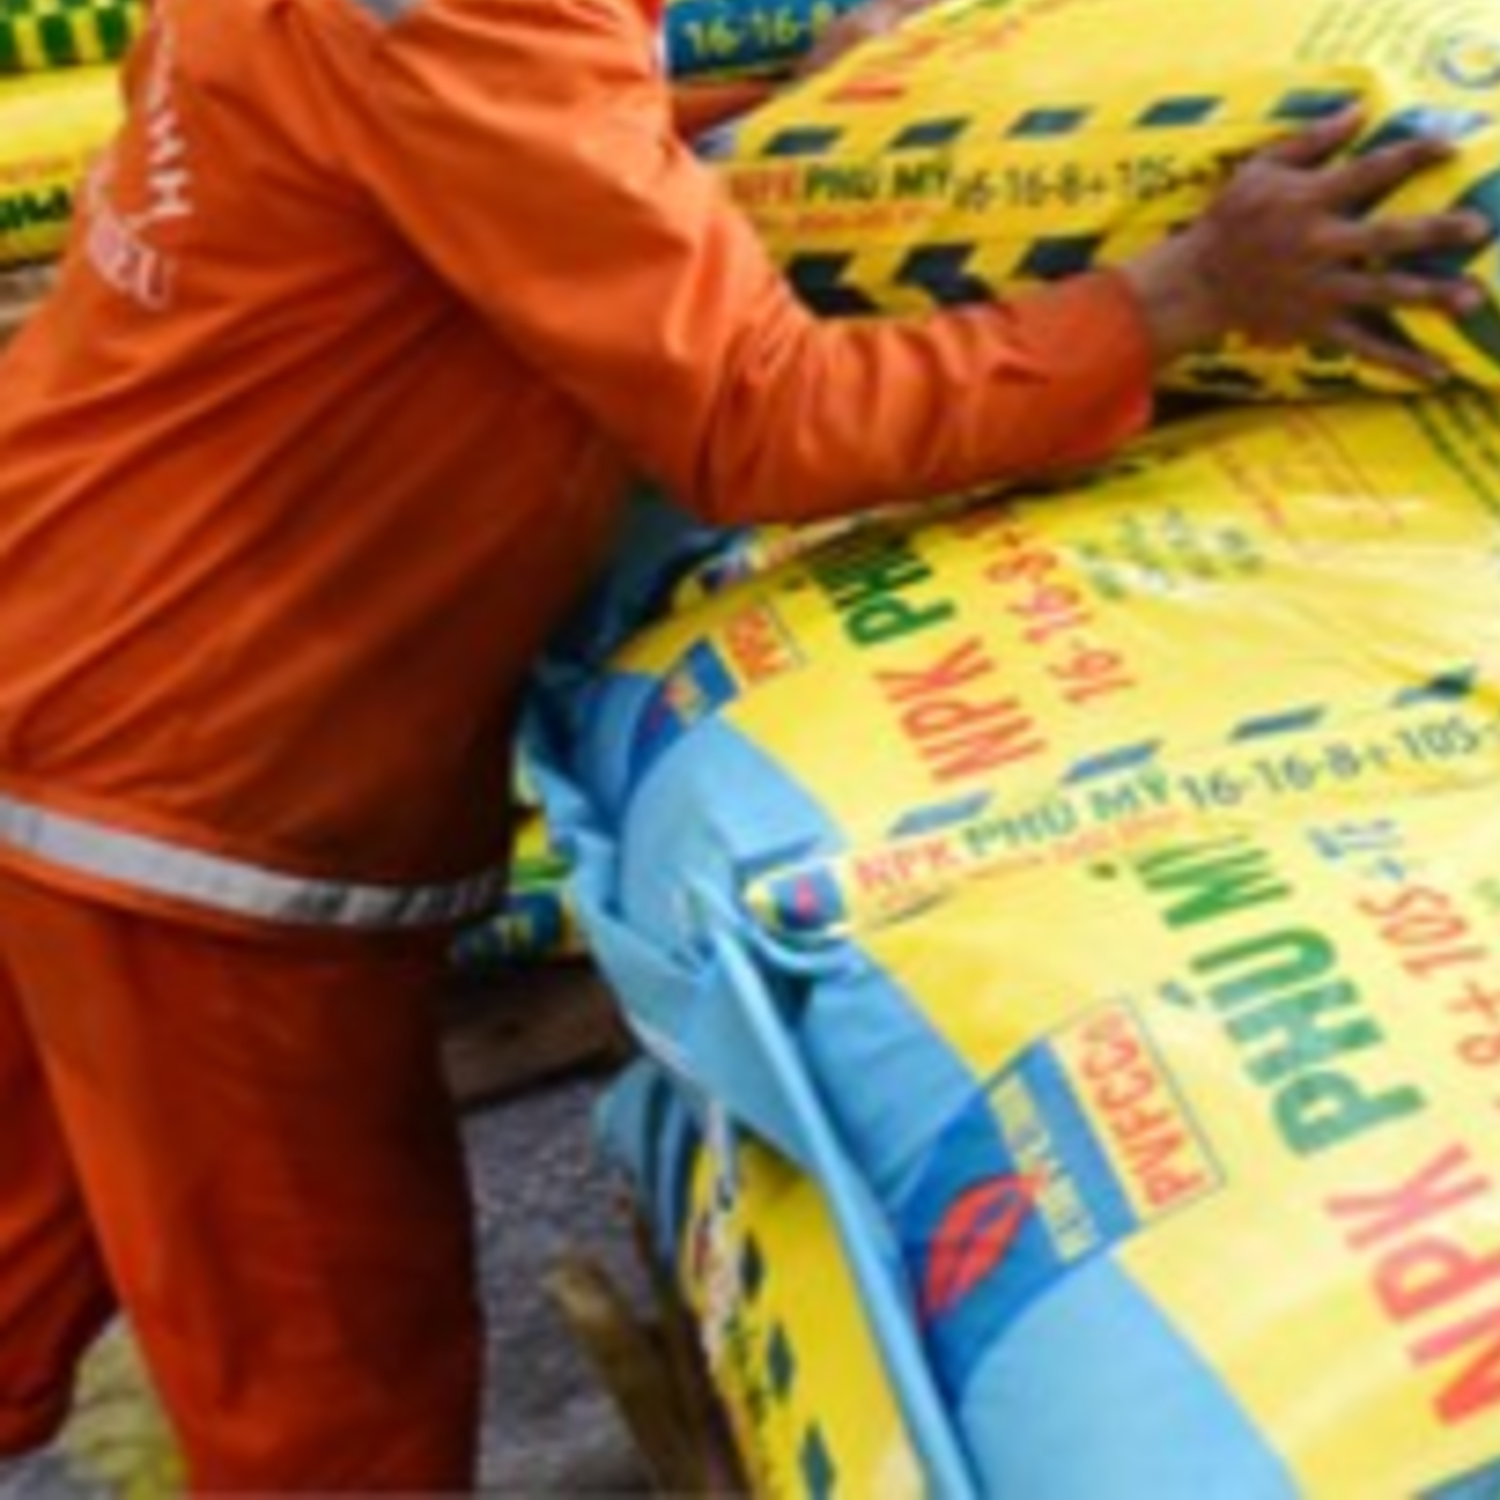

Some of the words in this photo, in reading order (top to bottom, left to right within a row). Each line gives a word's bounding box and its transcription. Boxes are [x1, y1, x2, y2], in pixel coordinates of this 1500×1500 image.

[870, 634, 1048, 784] NPK
[852, 836, 958, 894] NPK
[1156, 924, 1428, 1158] PHÚ
